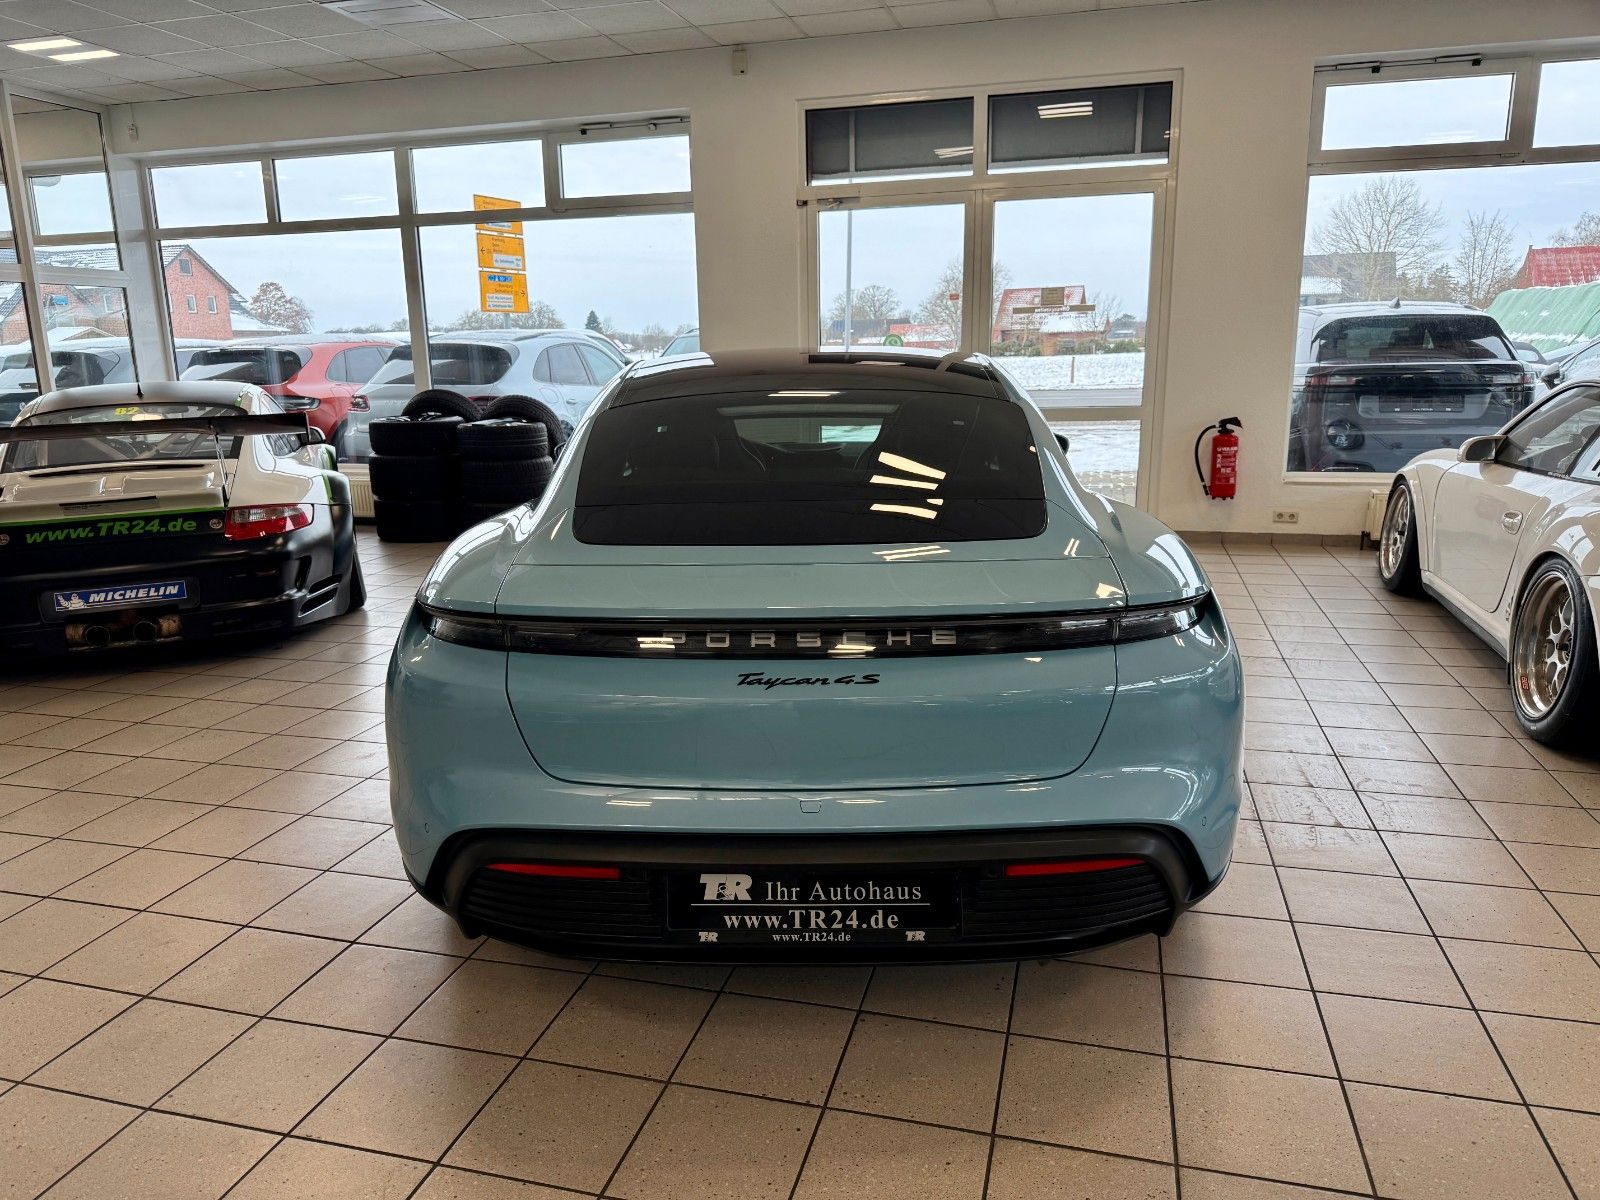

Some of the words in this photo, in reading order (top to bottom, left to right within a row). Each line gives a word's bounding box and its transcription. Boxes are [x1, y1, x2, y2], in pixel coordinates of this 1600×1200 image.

[25, 517, 198, 545] www.TR24.de
[88, 584, 180, 603] MICHELIN
[662, 629, 957, 648] PORSCHE
[737, 672, 830, 690] Taycan
[833, 673, 881, 685] 4S
[765, 881, 799, 901] Ihr
[809, 881, 923, 901] Autohaus
[723, 909, 900, 929] www.TR24.de
[771, 932, 852, 942] www.TR24.de
